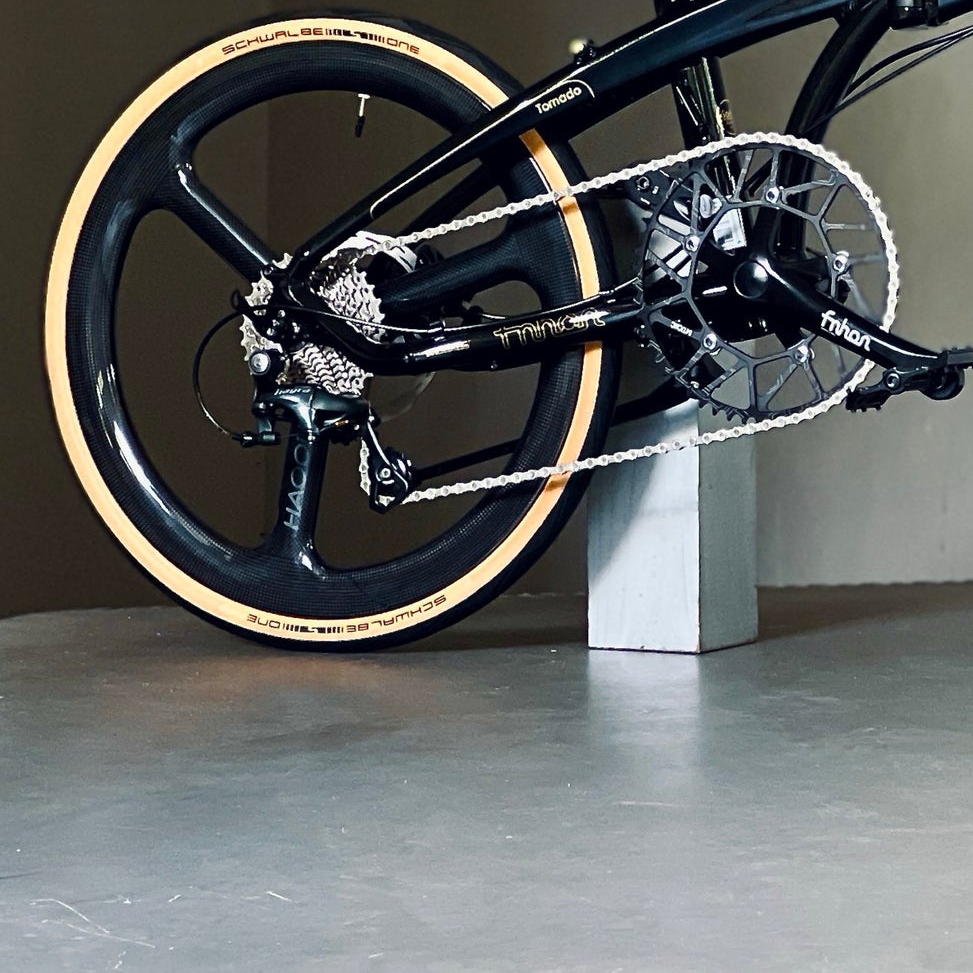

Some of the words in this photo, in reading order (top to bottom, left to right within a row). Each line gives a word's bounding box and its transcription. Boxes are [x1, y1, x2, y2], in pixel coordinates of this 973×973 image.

[222, 28, 324, 55] SCHWALBE
[387, 37, 420, 55] ONE
[535, 87, 582, 114] Tornado
[821, 310, 870, 352] fnhon
[246, 613, 281, 629] ONE
[346, 594, 447, 633] SCHWALBE
